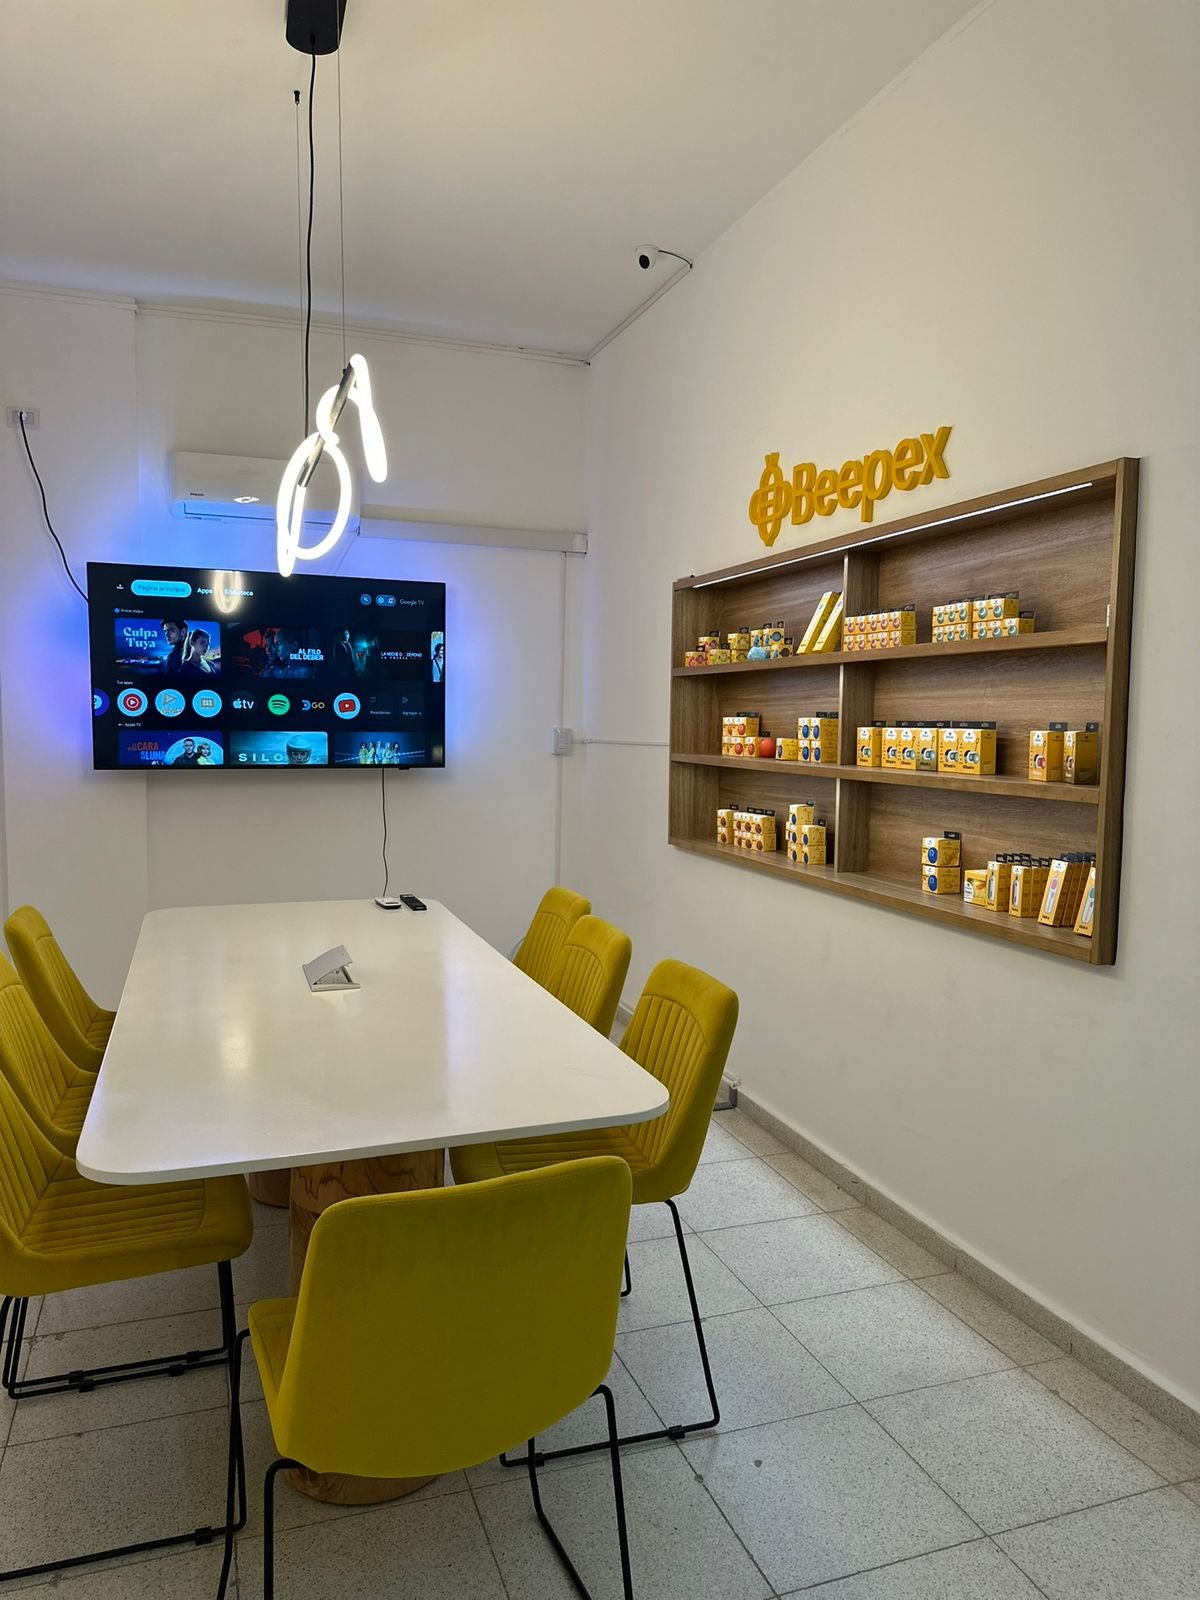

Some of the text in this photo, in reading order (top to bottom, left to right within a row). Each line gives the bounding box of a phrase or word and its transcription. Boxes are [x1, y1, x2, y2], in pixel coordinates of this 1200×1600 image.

[791, 426, 952, 526] Beepex
[400, 599, 417, 607] Google
[123, 627, 158, 639] Culpa
[126, 638, 156, 650] Tuya
[242, 700, 255, 710] tv
[138, 742, 159, 751] CARA
[145, 751, 166, 760] LUNA
[238, 753, 283, 762] SILO
